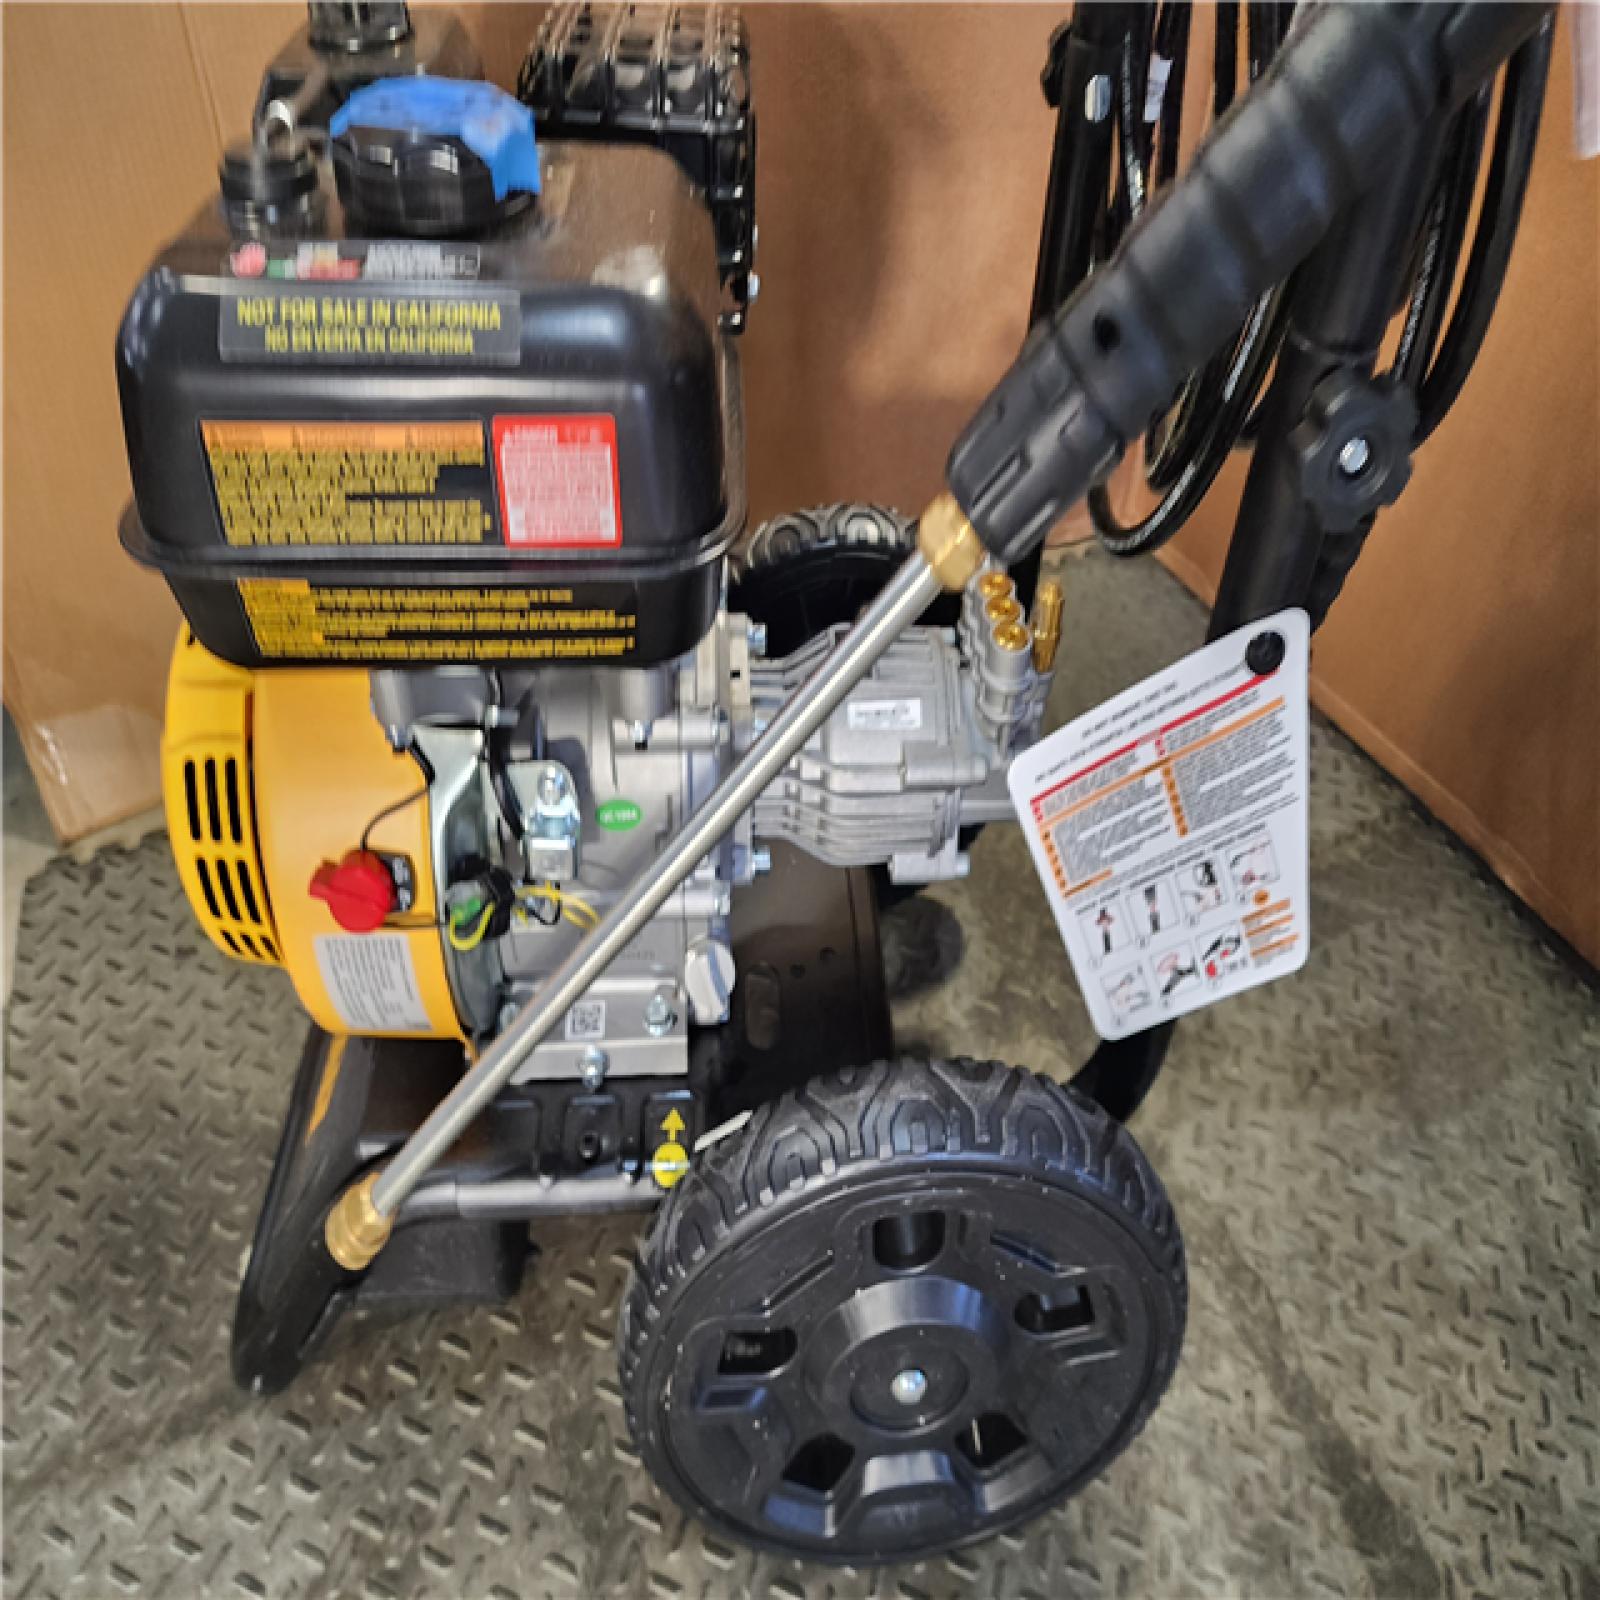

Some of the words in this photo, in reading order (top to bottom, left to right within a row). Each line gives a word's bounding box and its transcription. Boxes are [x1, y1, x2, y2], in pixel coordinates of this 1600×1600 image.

[237, 296, 274, 326] NOT
[281, 296, 316, 325] FOR
[322, 296, 366, 328] SALE
[372, 297, 391, 328] IN
[395, 299, 501, 330] CALIFORNIA
